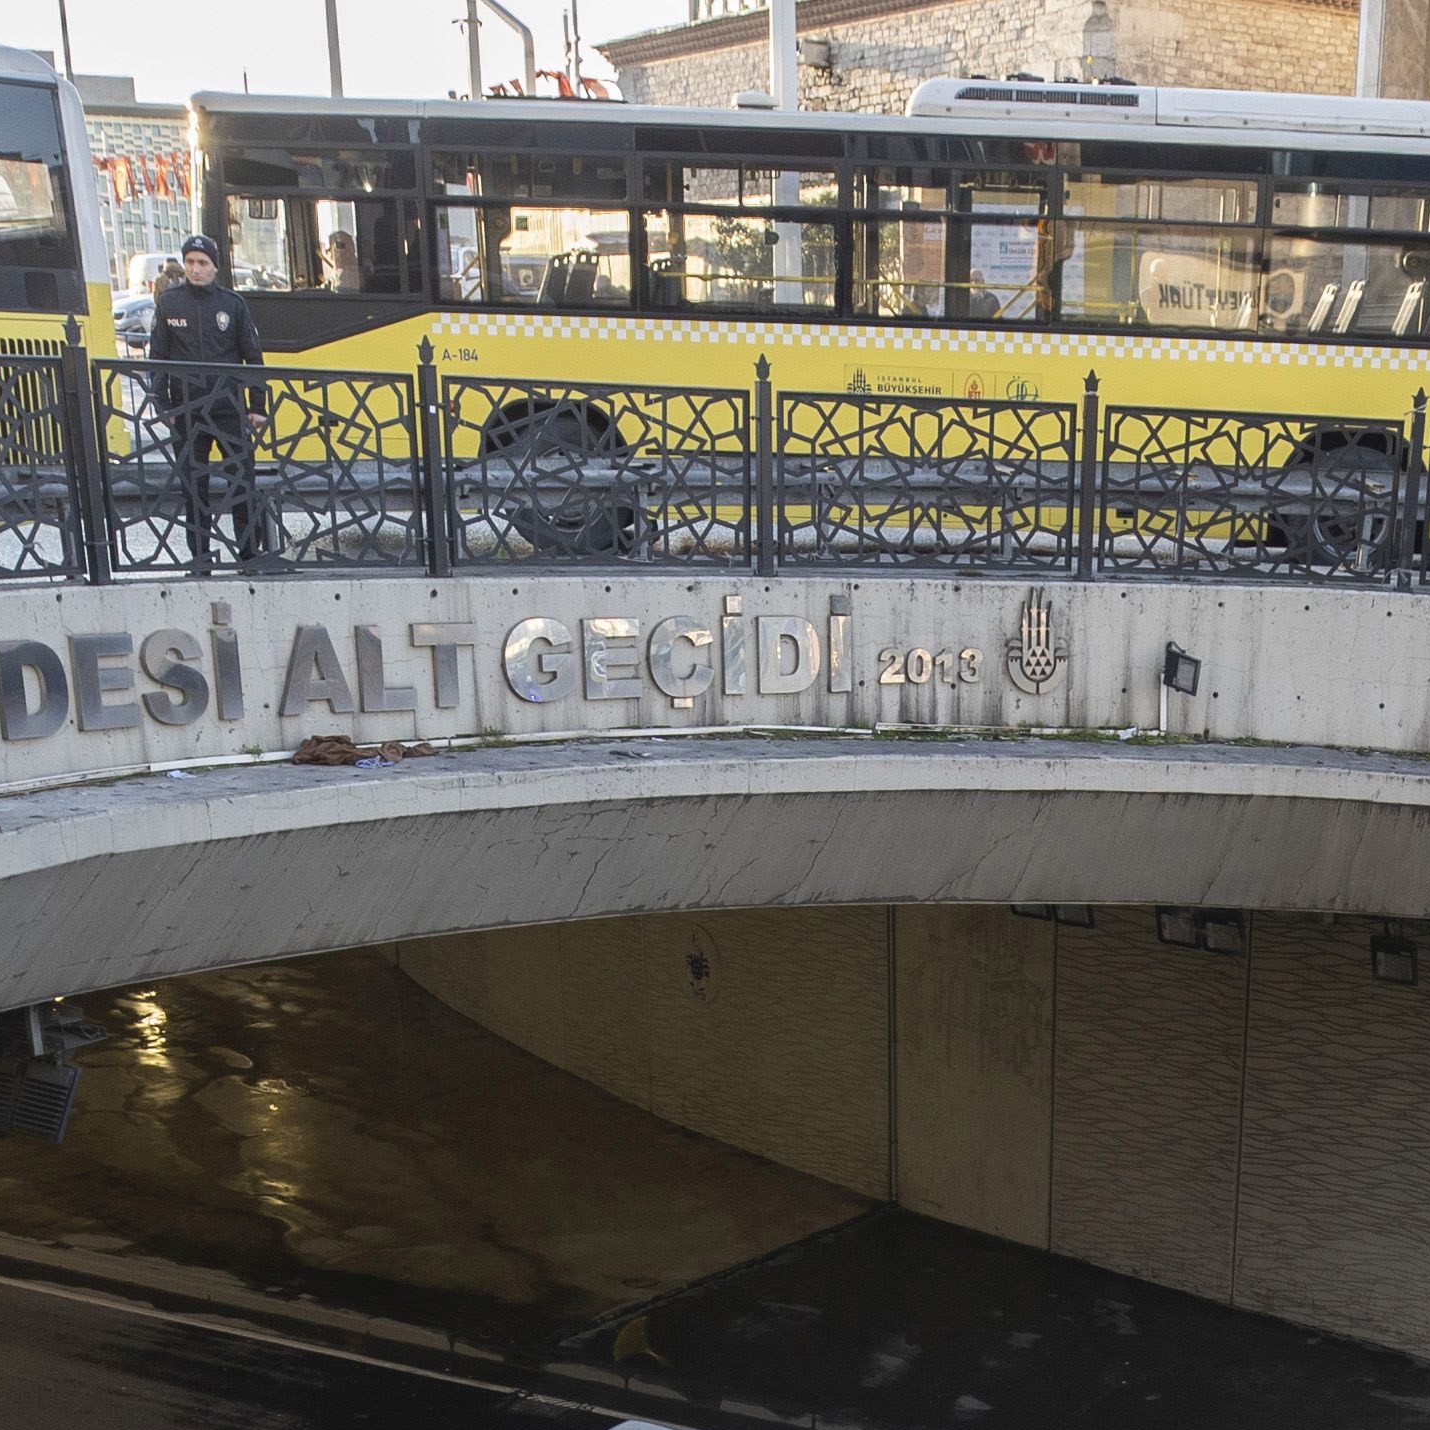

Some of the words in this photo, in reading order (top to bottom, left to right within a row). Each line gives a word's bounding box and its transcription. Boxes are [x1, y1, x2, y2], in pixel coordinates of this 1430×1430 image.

[442, 348, 479, 361] A-184
[876, 383, 943, 396] BÜYÜKŞEHİR
[279, 621, 476, 717] ALT
[501, 593, 854, 710] GEÇİDİ
[877, 646, 985, 685] 2013
